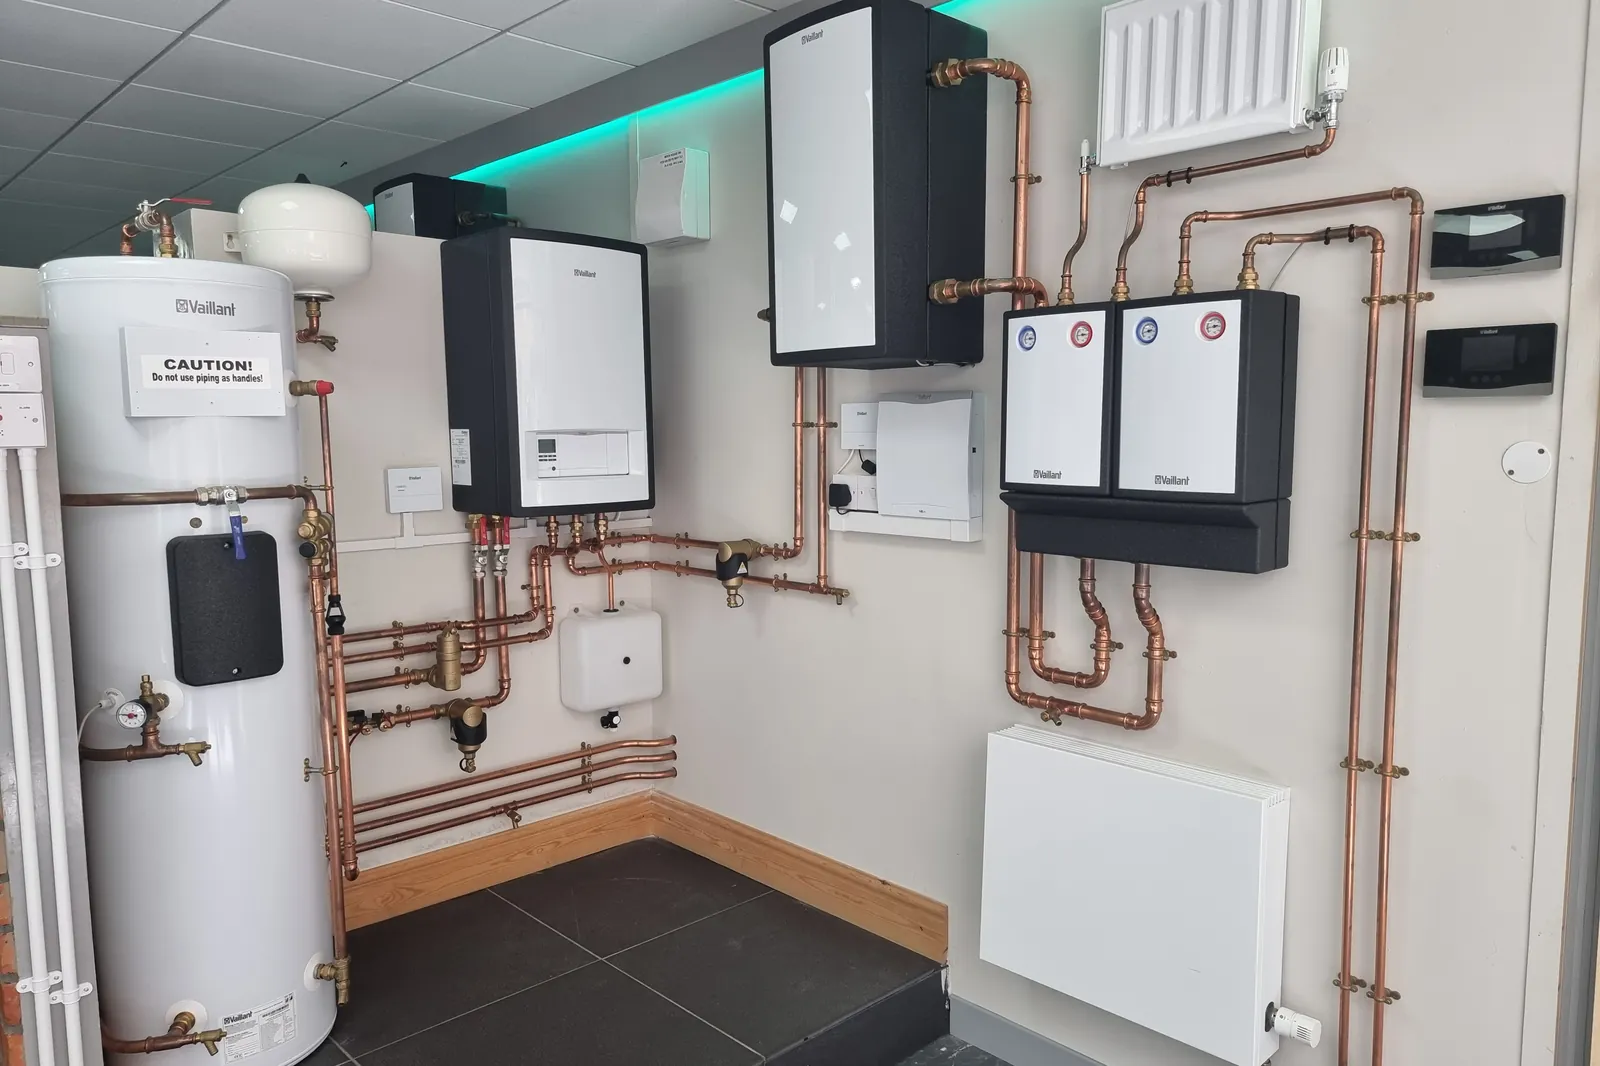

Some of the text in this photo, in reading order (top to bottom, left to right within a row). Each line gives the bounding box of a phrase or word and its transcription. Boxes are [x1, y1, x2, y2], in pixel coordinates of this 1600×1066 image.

[189, 299, 237, 317] Vaillant
[164, 358, 253, 371] CAUTION!
[152, 372, 264, 384] Do not use piping as handles!
[1038, 469, 1062, 480] Vaillant
[1161, 474, 1190, 486] Vaillant
[230, 1010, 253, 1023] Vaillant
